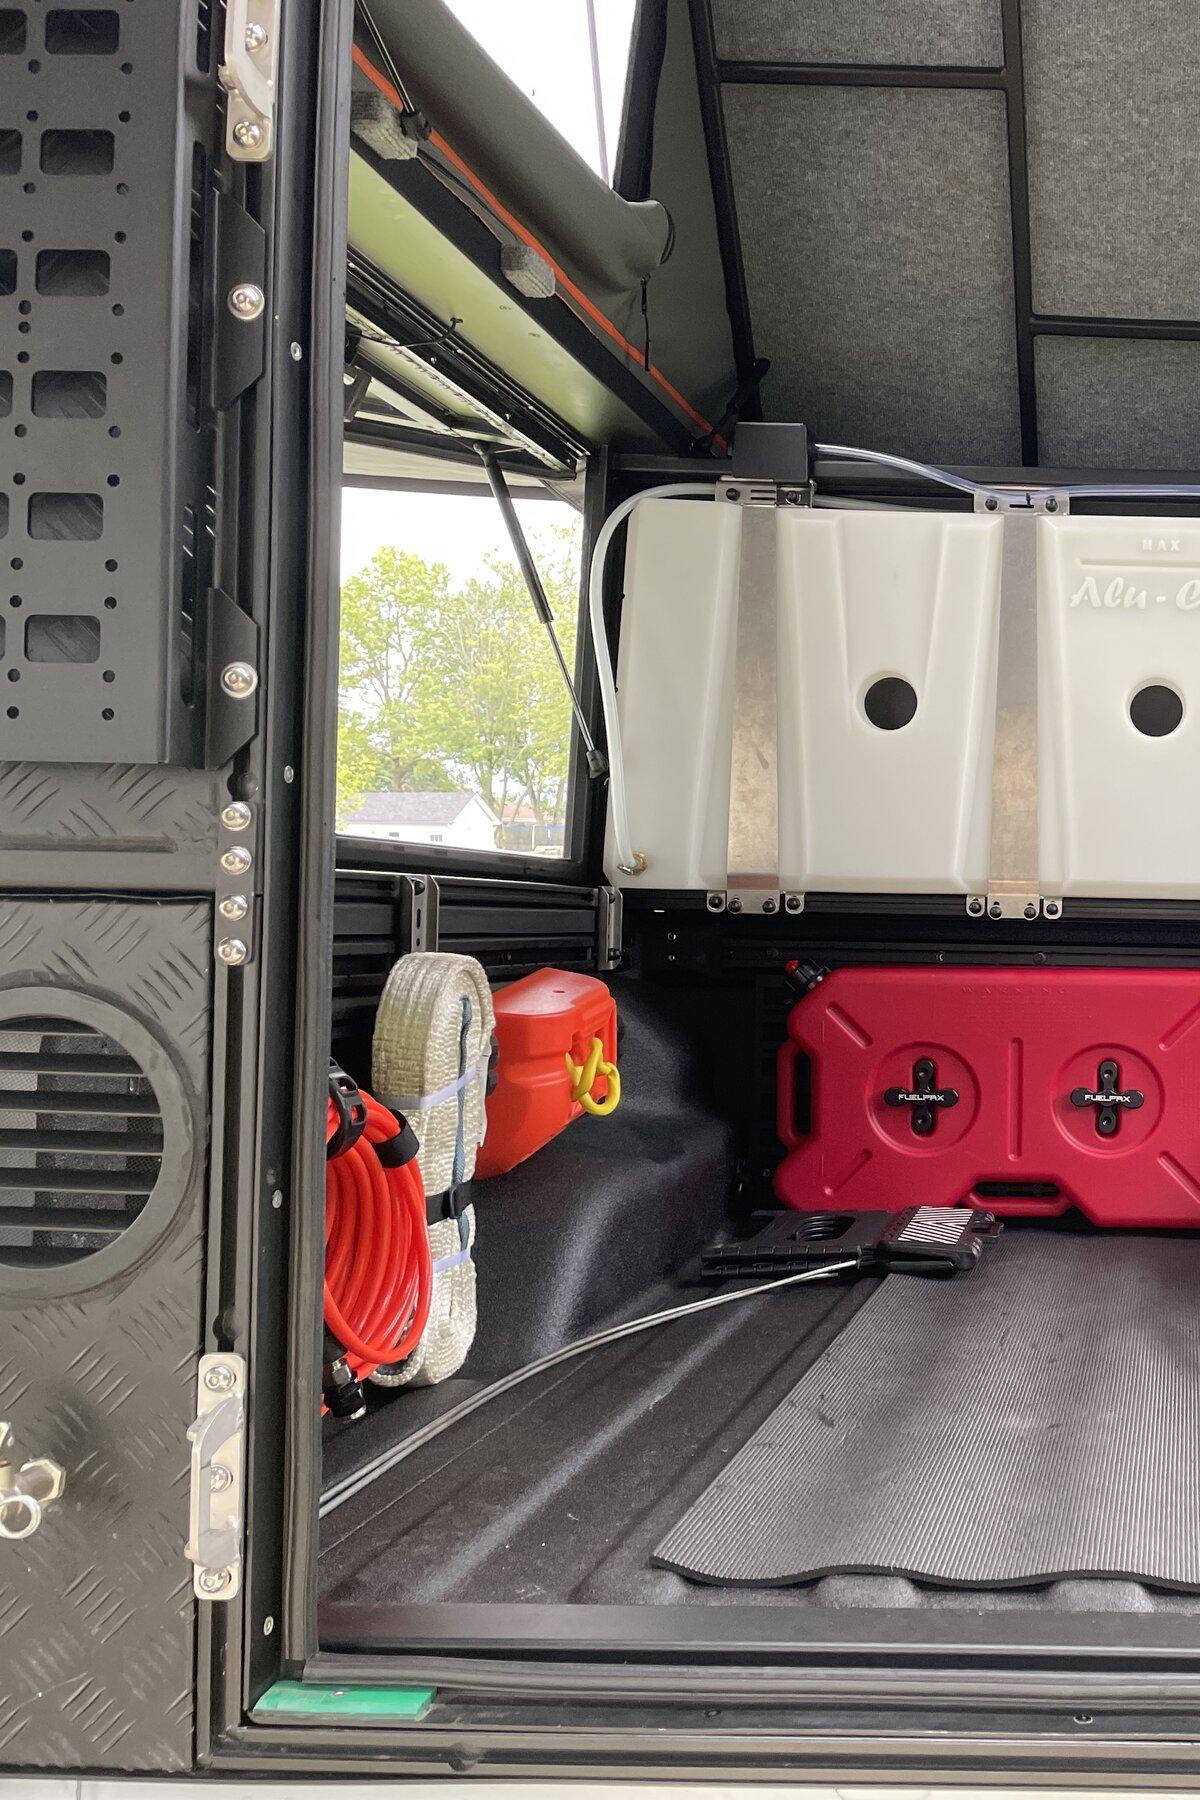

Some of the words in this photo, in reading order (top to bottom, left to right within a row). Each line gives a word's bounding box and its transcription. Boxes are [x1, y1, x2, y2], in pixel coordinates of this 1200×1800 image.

[1142, 539, 1181, 552] MAX
[898, 1094, 945, 1102] FUELPAX
[1084, 1094, 1131, 1103] FUELPAX
